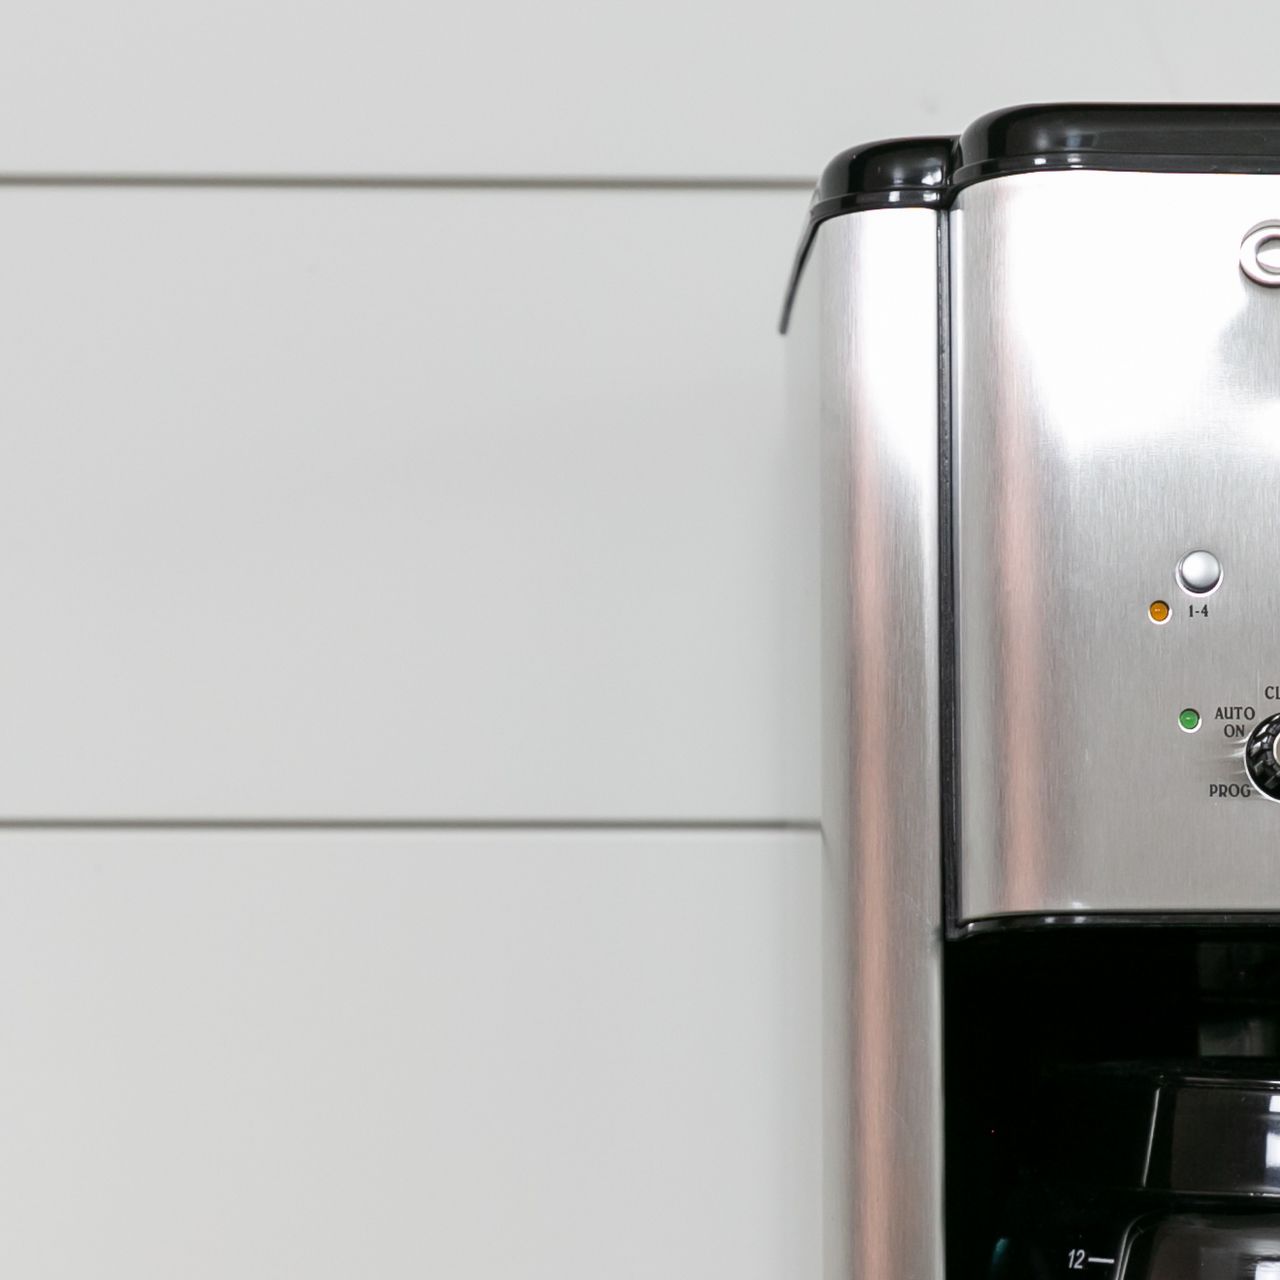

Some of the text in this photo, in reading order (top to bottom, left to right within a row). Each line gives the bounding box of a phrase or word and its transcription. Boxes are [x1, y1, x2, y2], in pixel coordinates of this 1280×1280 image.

[1188, 604, 1210, 618] 1-4
[1214, 706, 1256, 721] AUTO
[1223, 723, 1246, 738] ON
[1209, 783, 1252, 798] PROG
[1067, 1249, 1086, 1269] 12
